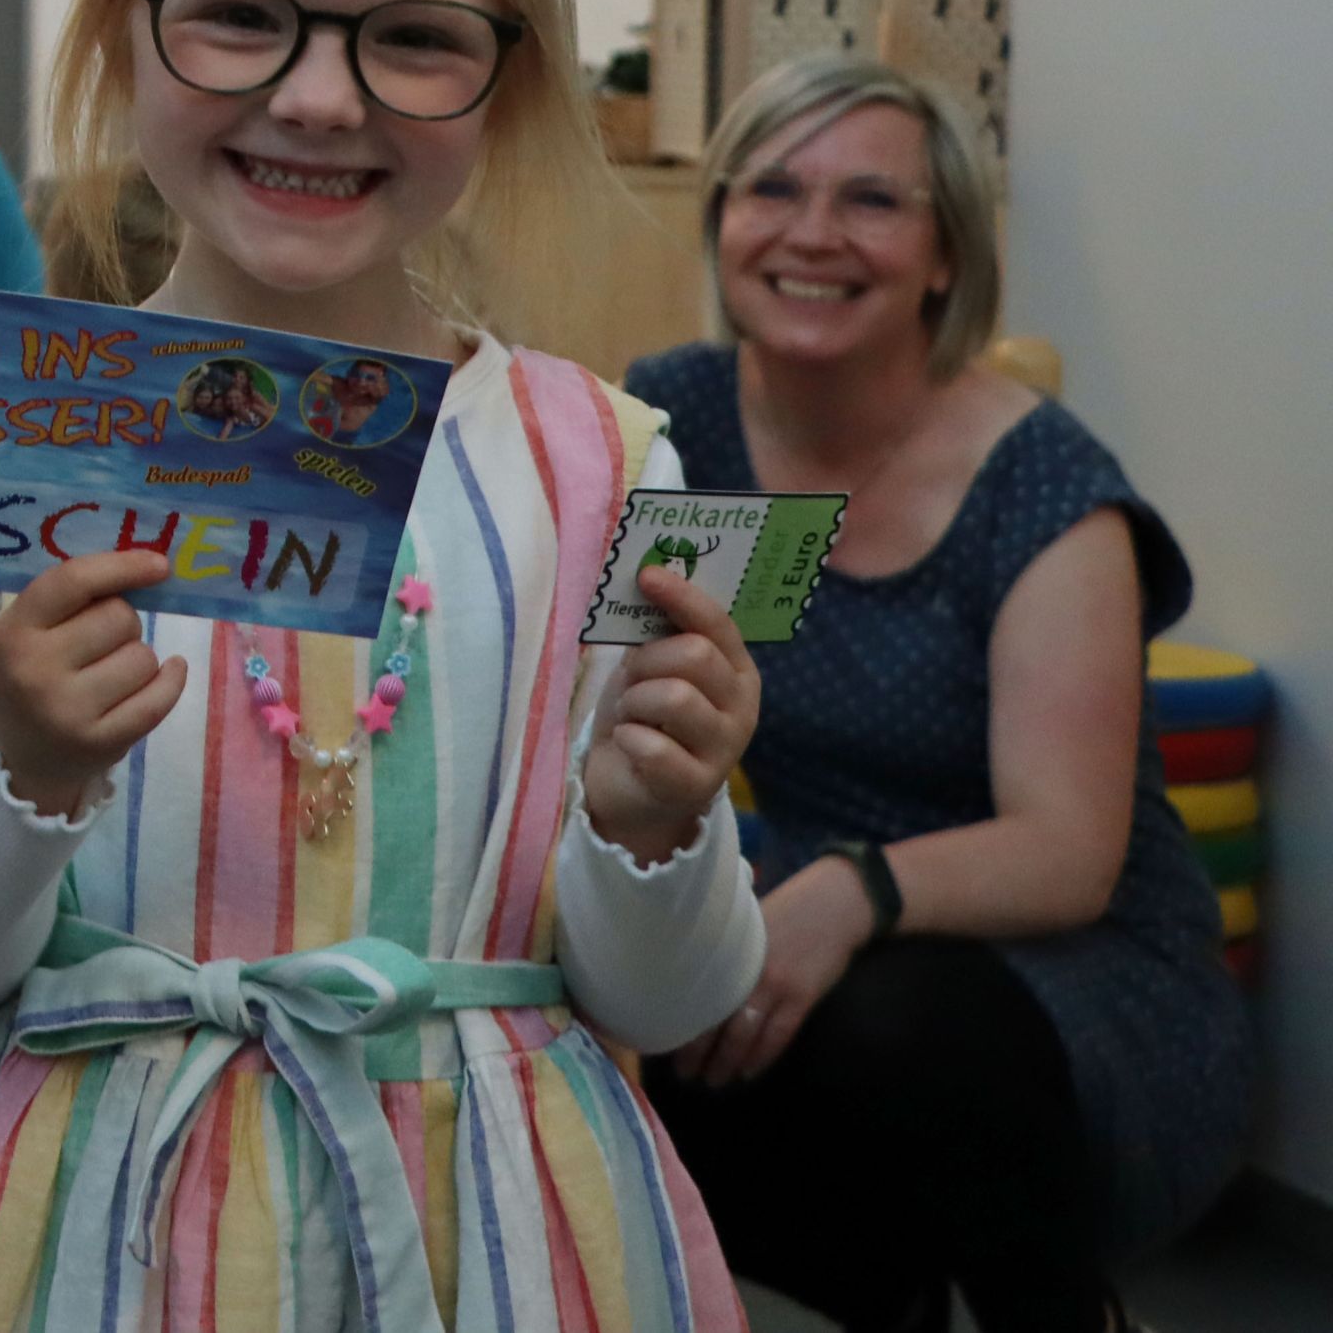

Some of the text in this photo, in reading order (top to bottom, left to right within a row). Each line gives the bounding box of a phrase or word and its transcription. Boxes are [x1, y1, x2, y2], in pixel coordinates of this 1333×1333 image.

[21, 328, 138, 381] INS
[152, 338, 245, 358] schwimmen
[145, 466, 252, 487] Badespaß
[294, 447, 378, 497] spielen
[635, 500, 759, 529] Freikarte
[745, 530, 789, 609] Kinder
[774, 532, 818, 609] 3 Euro
